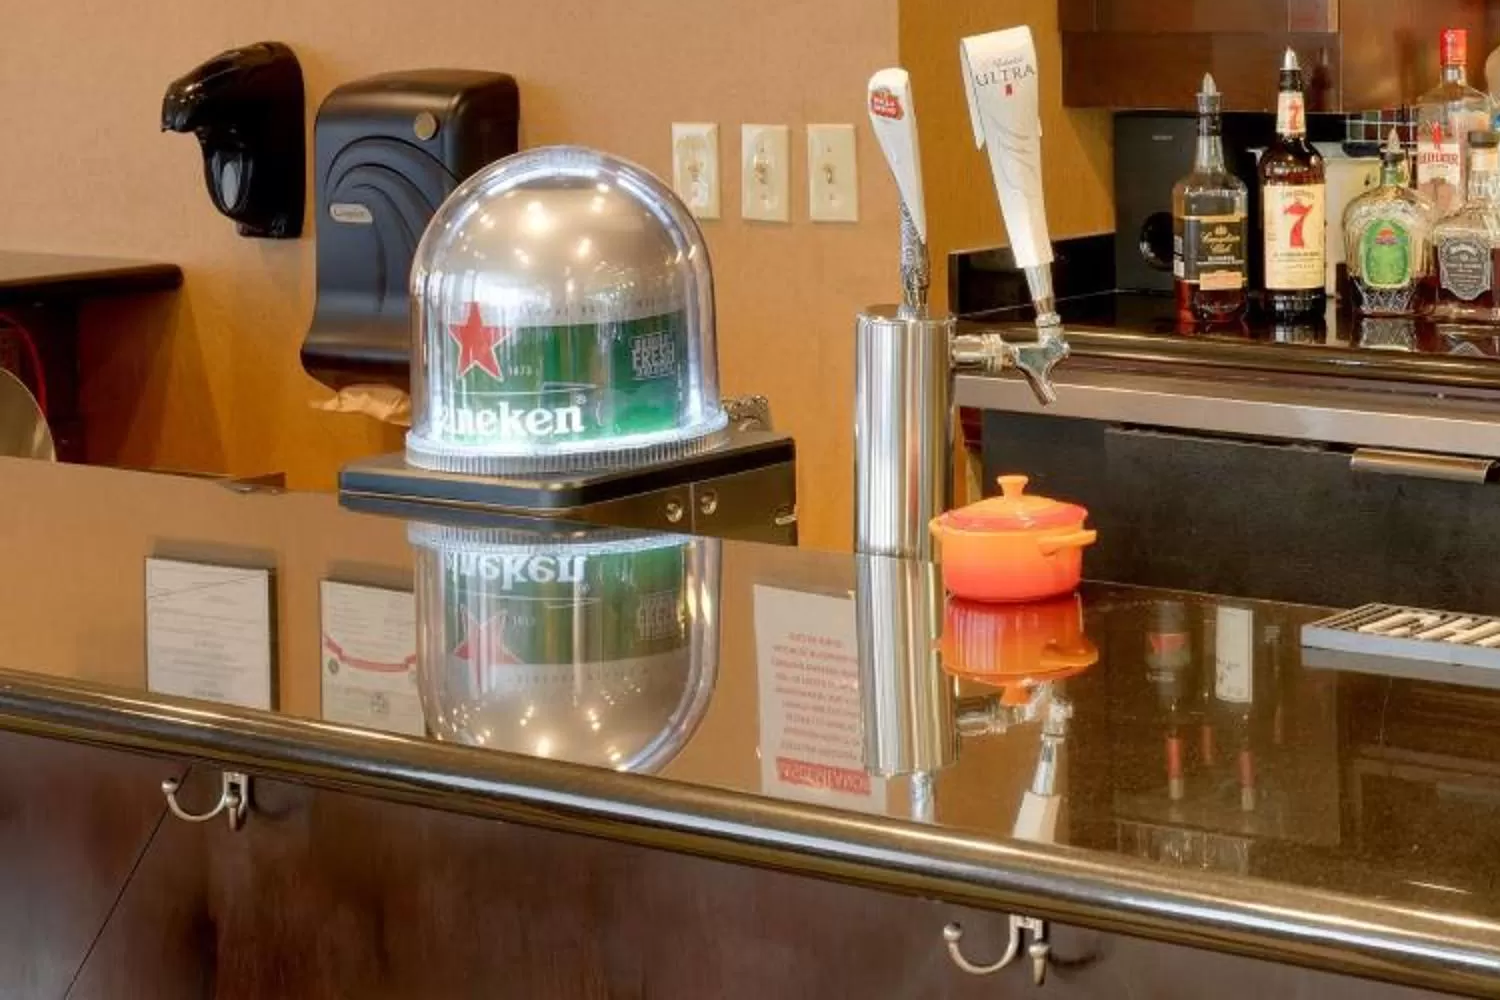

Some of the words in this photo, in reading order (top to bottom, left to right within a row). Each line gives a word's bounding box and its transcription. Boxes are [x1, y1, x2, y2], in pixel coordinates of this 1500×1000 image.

[975, 64, 1035, 86] ULTRA
[1288, 103, 1302, 130] 7
[1284, 200, 1314, 248] 7
